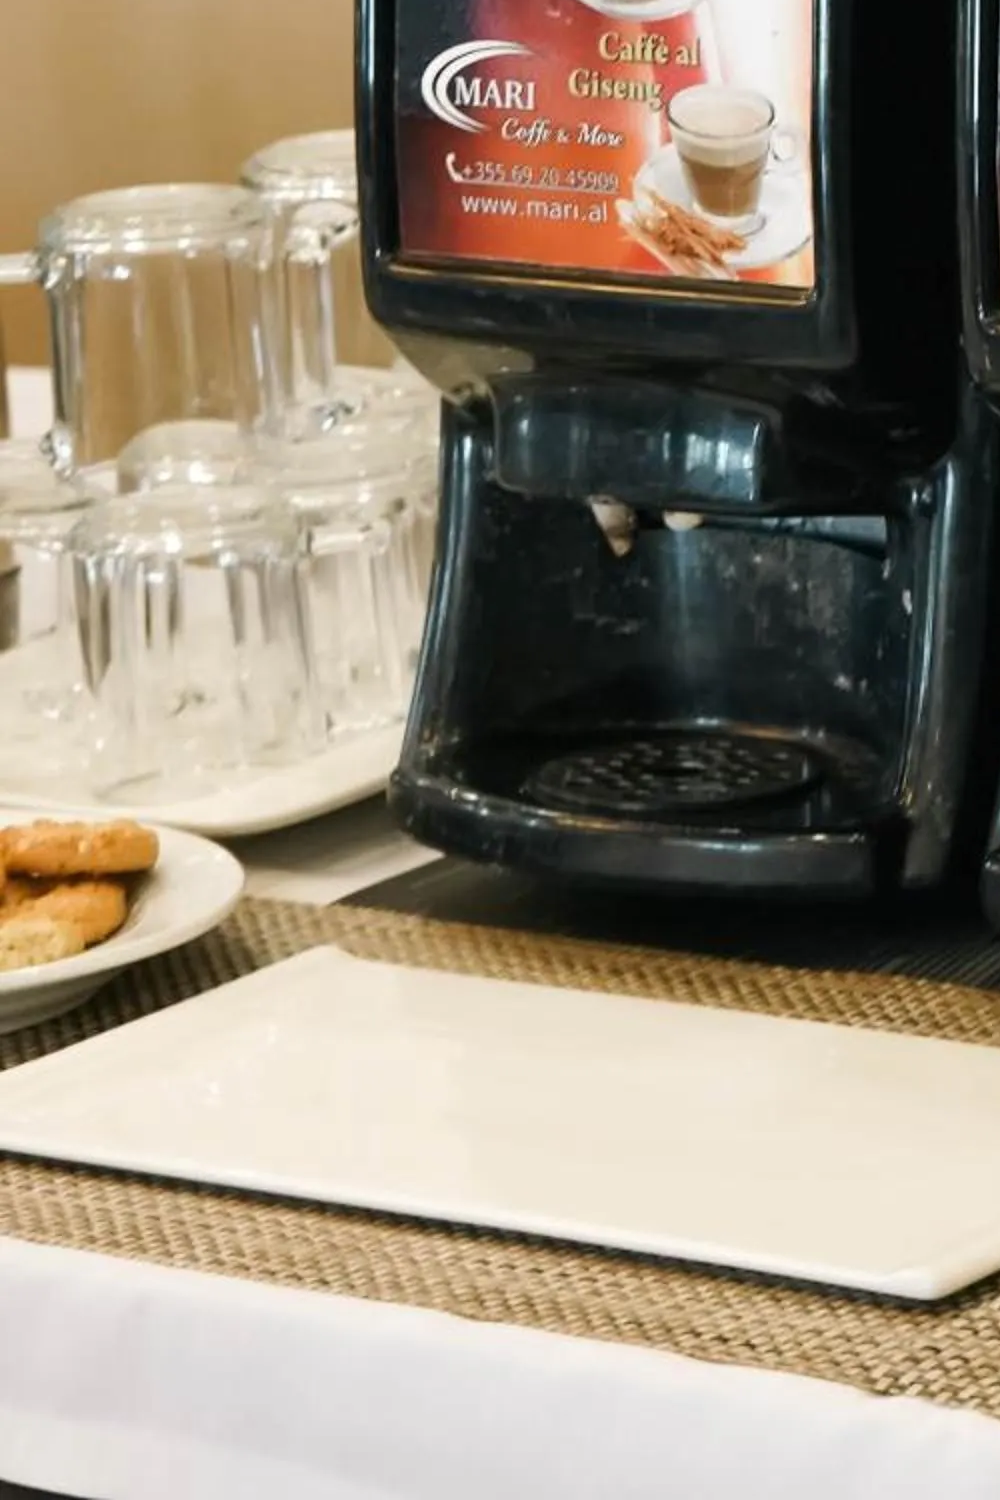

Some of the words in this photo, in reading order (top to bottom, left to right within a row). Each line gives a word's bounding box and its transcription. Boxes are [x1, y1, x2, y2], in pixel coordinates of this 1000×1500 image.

[598, 31, 669, 63] Caffè
[675, 37, 701, 67] al
[453, 76, 536, 111] MARI
[568, 68, 664, 112] Giseng
[577, 122, 624, 148] More
[463, 161, 506, 183] +355
[511, 164, 533, 185] 69
[539, 167, 559, 188] 20
[461, 195, 608, 223] www.mari.al
